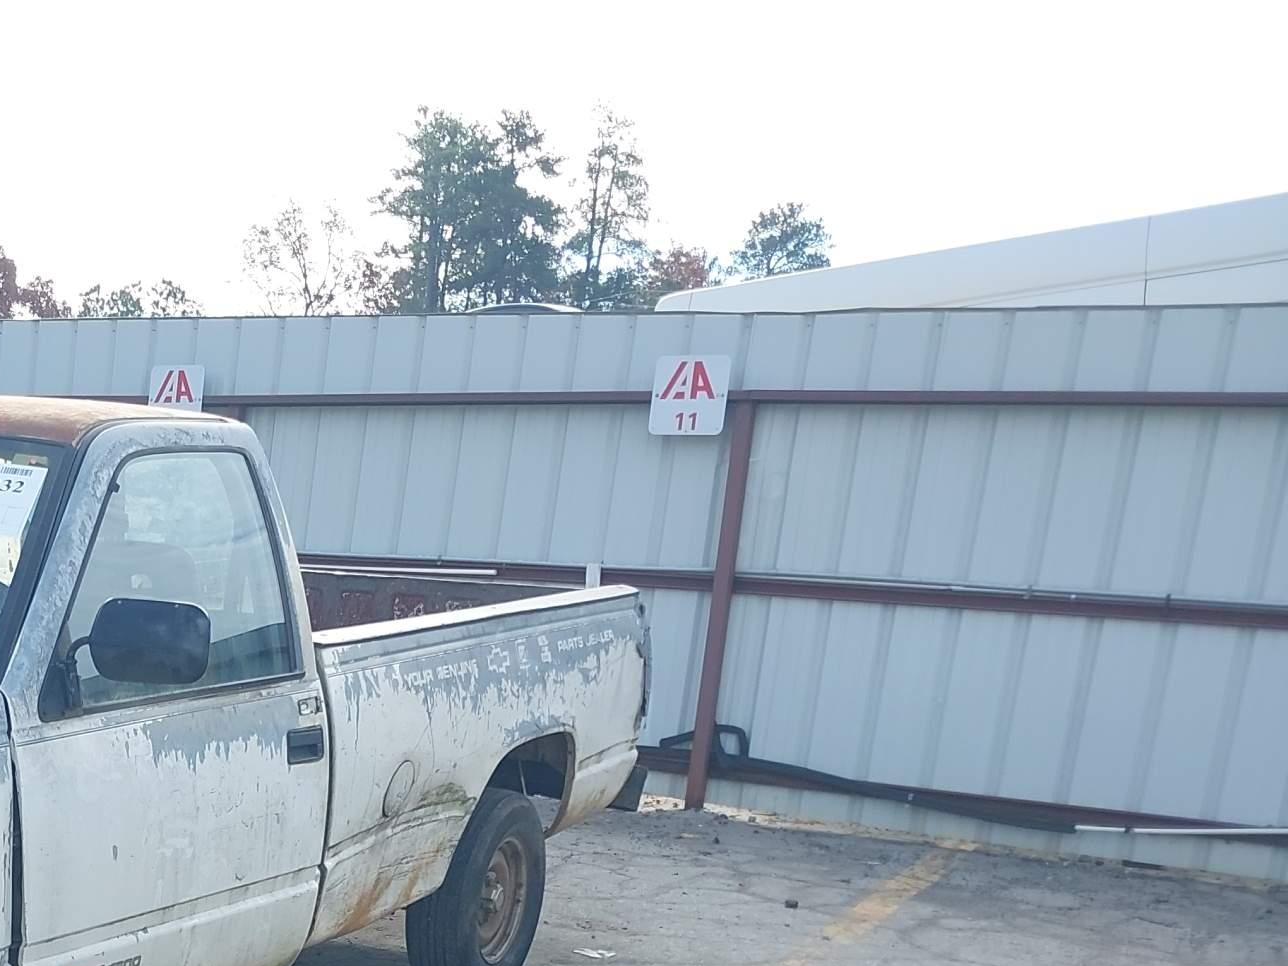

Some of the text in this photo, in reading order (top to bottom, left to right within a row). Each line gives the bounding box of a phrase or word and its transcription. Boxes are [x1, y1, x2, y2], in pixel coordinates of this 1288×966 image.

[675, 412, 698, 431] 11
[557, 636, 584, 653] PARTS
[403, 669, 434, 687] YOUR
